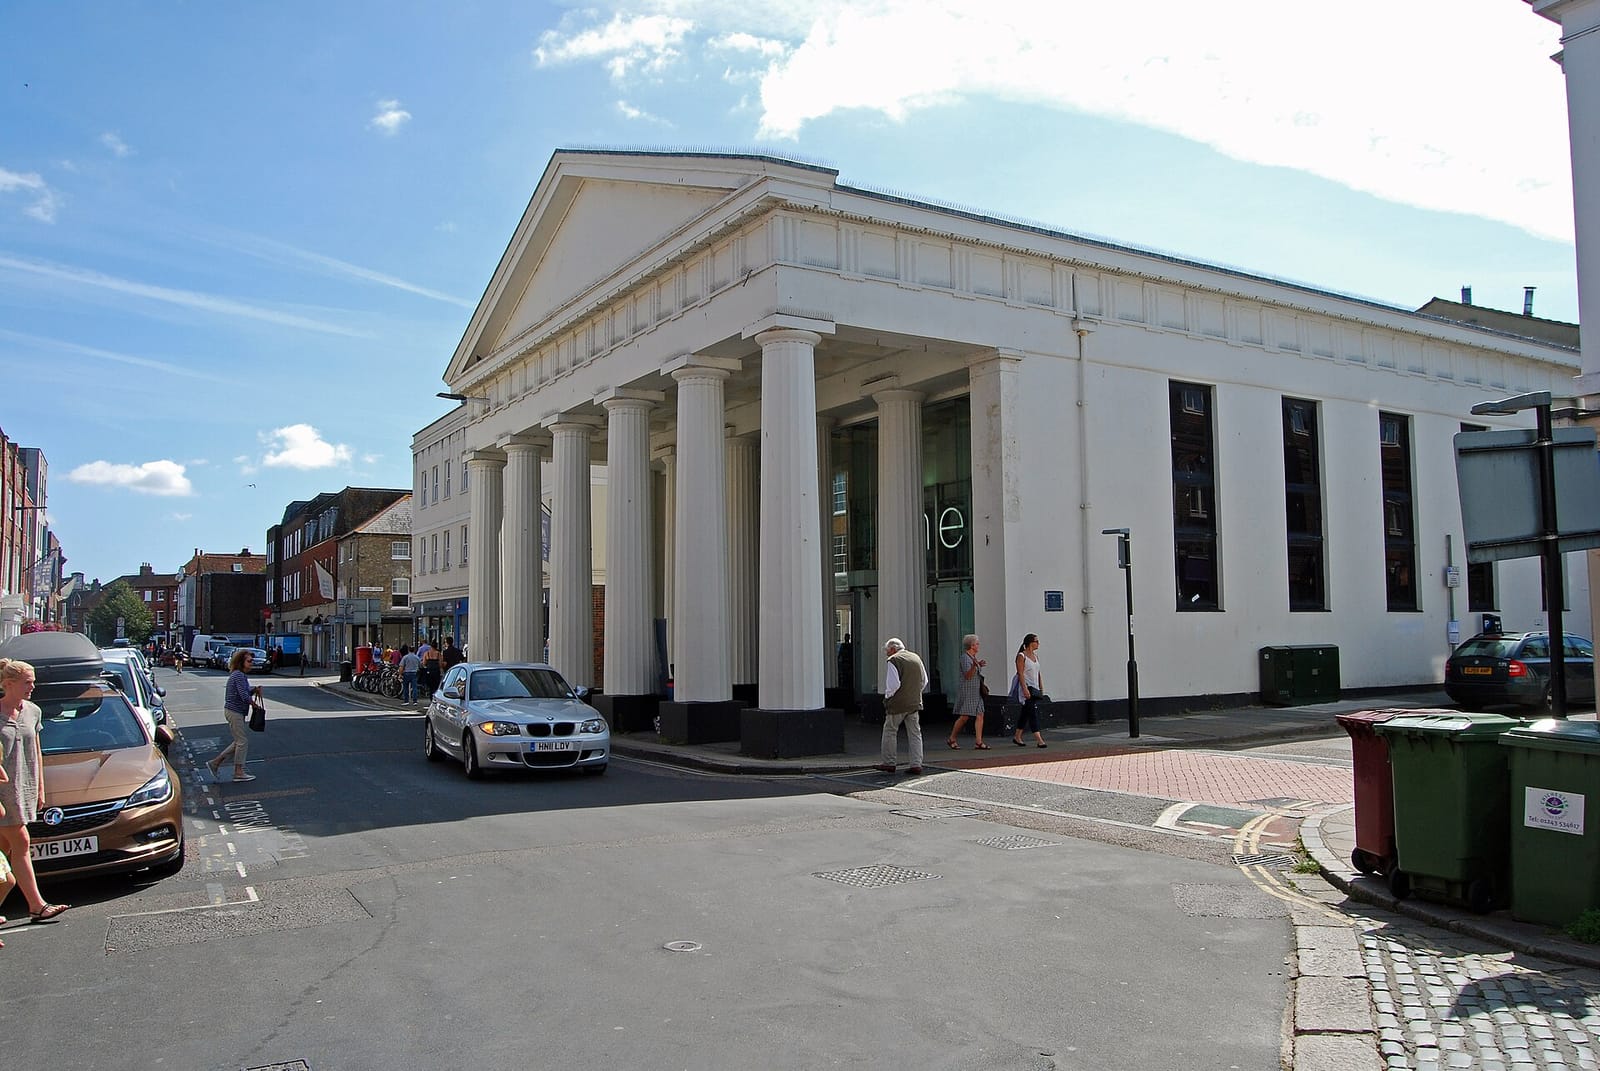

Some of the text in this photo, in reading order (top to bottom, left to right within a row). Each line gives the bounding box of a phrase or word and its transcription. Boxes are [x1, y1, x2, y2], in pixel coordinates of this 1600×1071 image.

[1541, 792, 1569, 807] CHICHESTER
[224, 800, 278, 833] DISABLED
[63, 838, 92, 853] UXA
